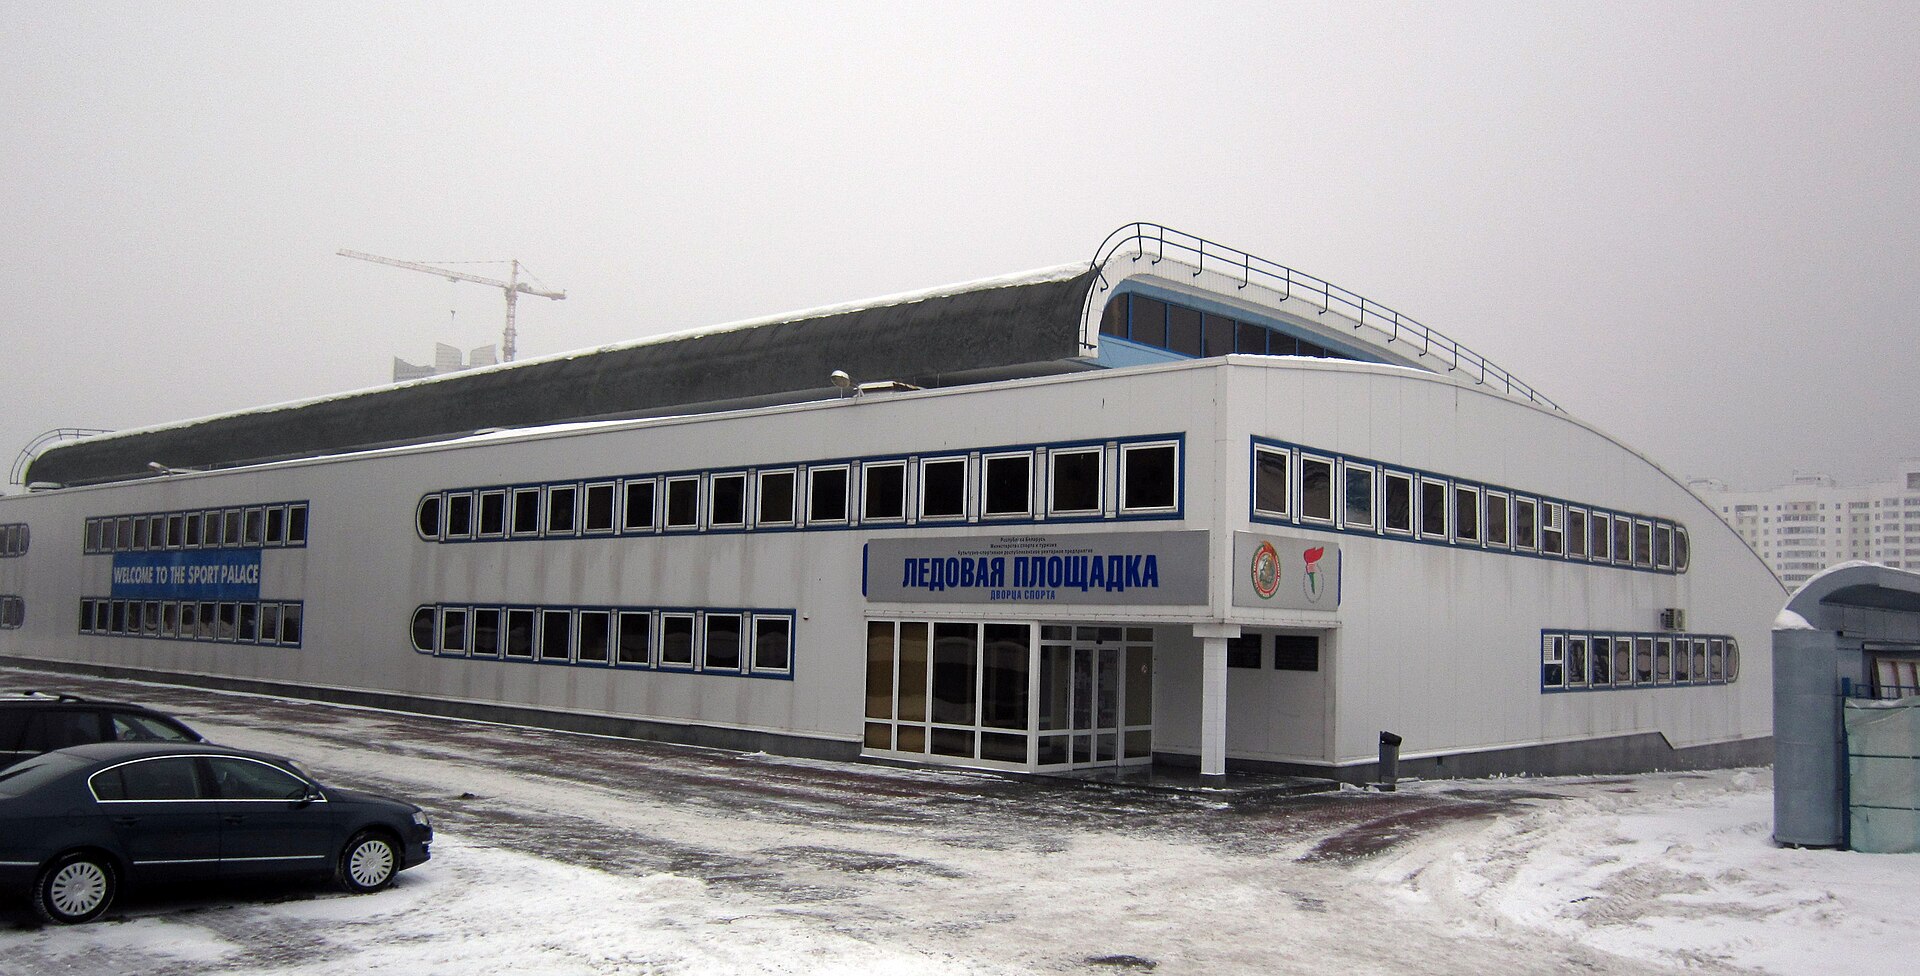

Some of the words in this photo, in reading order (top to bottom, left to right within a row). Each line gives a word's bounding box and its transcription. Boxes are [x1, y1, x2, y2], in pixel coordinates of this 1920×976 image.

[114, 566, 153, 584] WELCOME
[156, 566, 168, 584] TO
[170, 566, 185, 584] THE
[188, 565, 219, 584] SPORT
[221, 564, 259, 584] PALACE
[902, 555, 1005, 591] ЛЕДОВАЯ
[1013, 554, 1159, 592] ПЛОЩАДКА
[990, 589, 1022, 601] ДВОРЦА
[1024, 589, 1056, 600] СПОРТА
